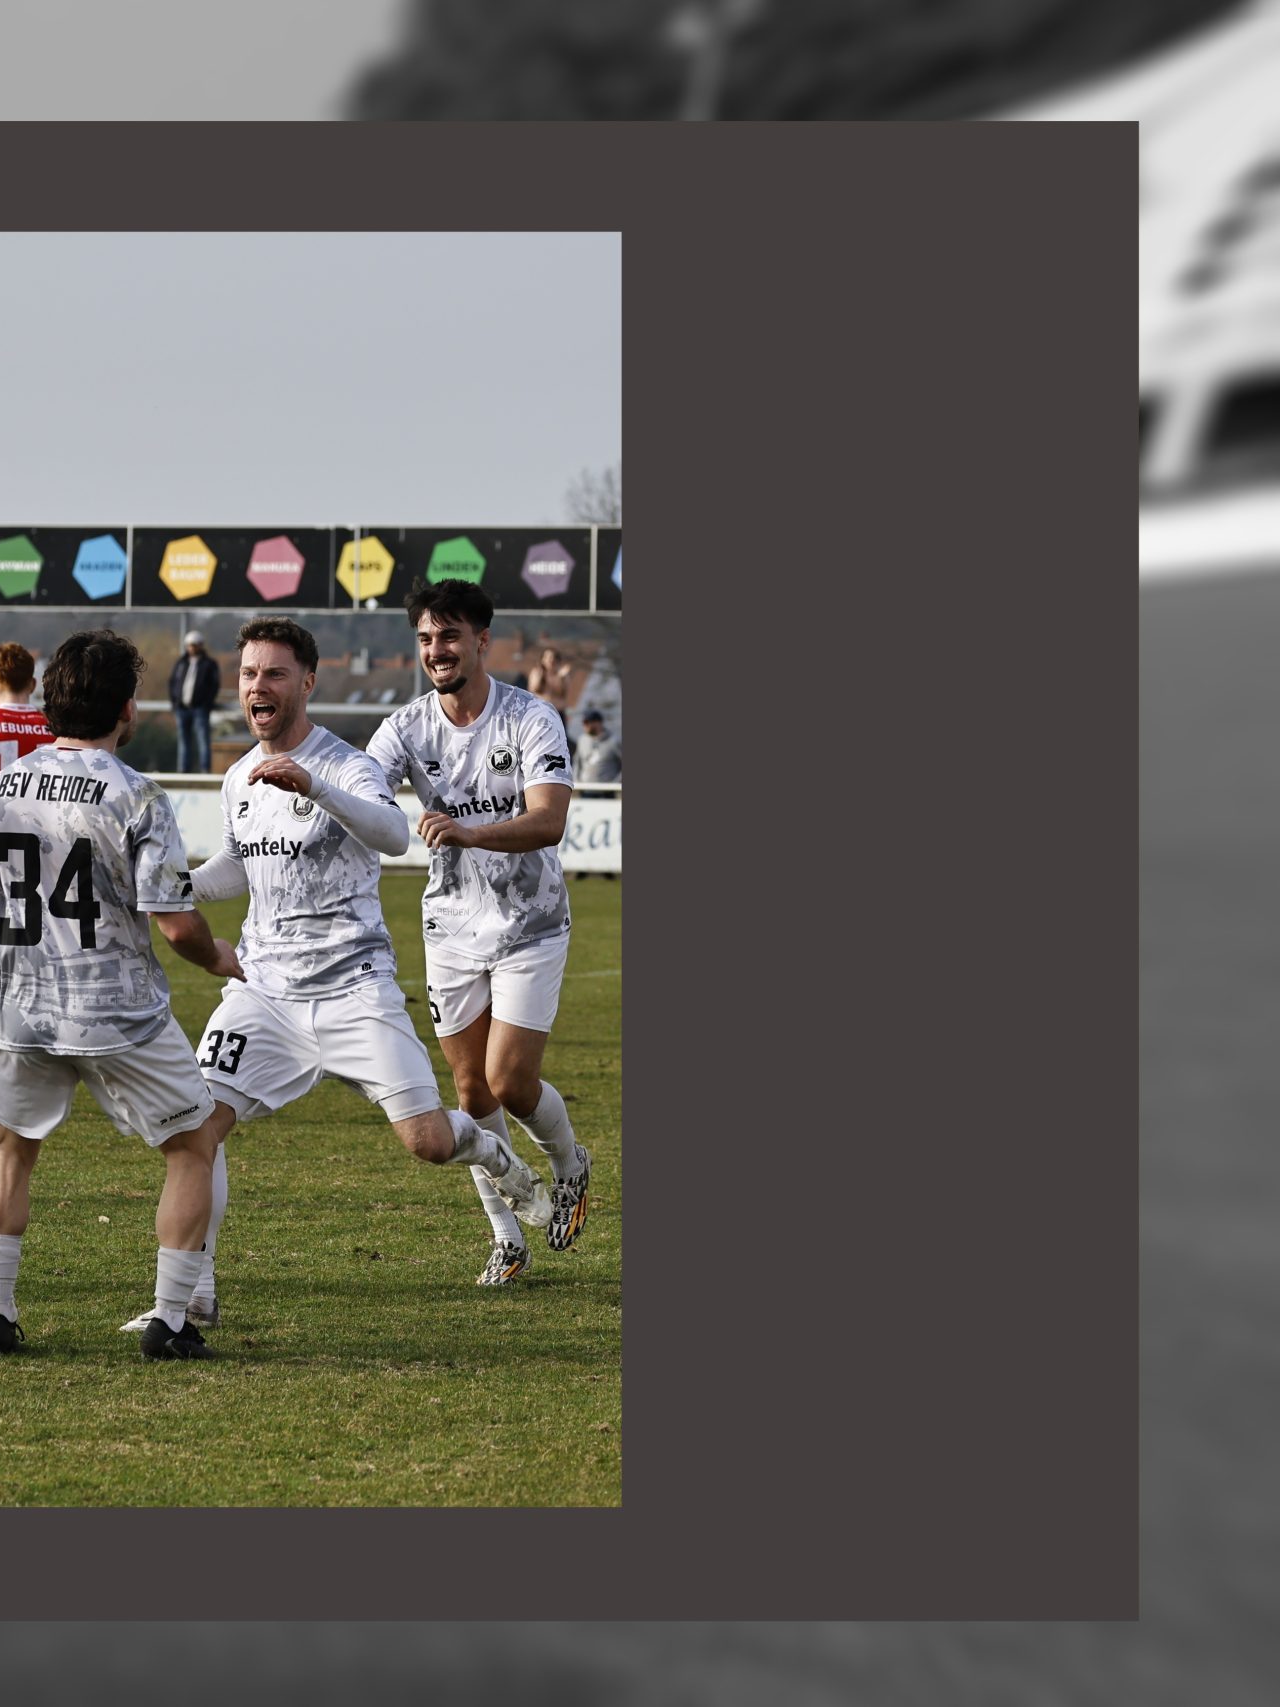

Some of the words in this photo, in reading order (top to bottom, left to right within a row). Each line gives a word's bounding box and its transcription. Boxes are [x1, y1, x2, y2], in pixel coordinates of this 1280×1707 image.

[36, 774, 108, 805] REHDEN
[199, 1030, 248, 1075] 33
[169, 1103, 200, 1121] PATRICK
